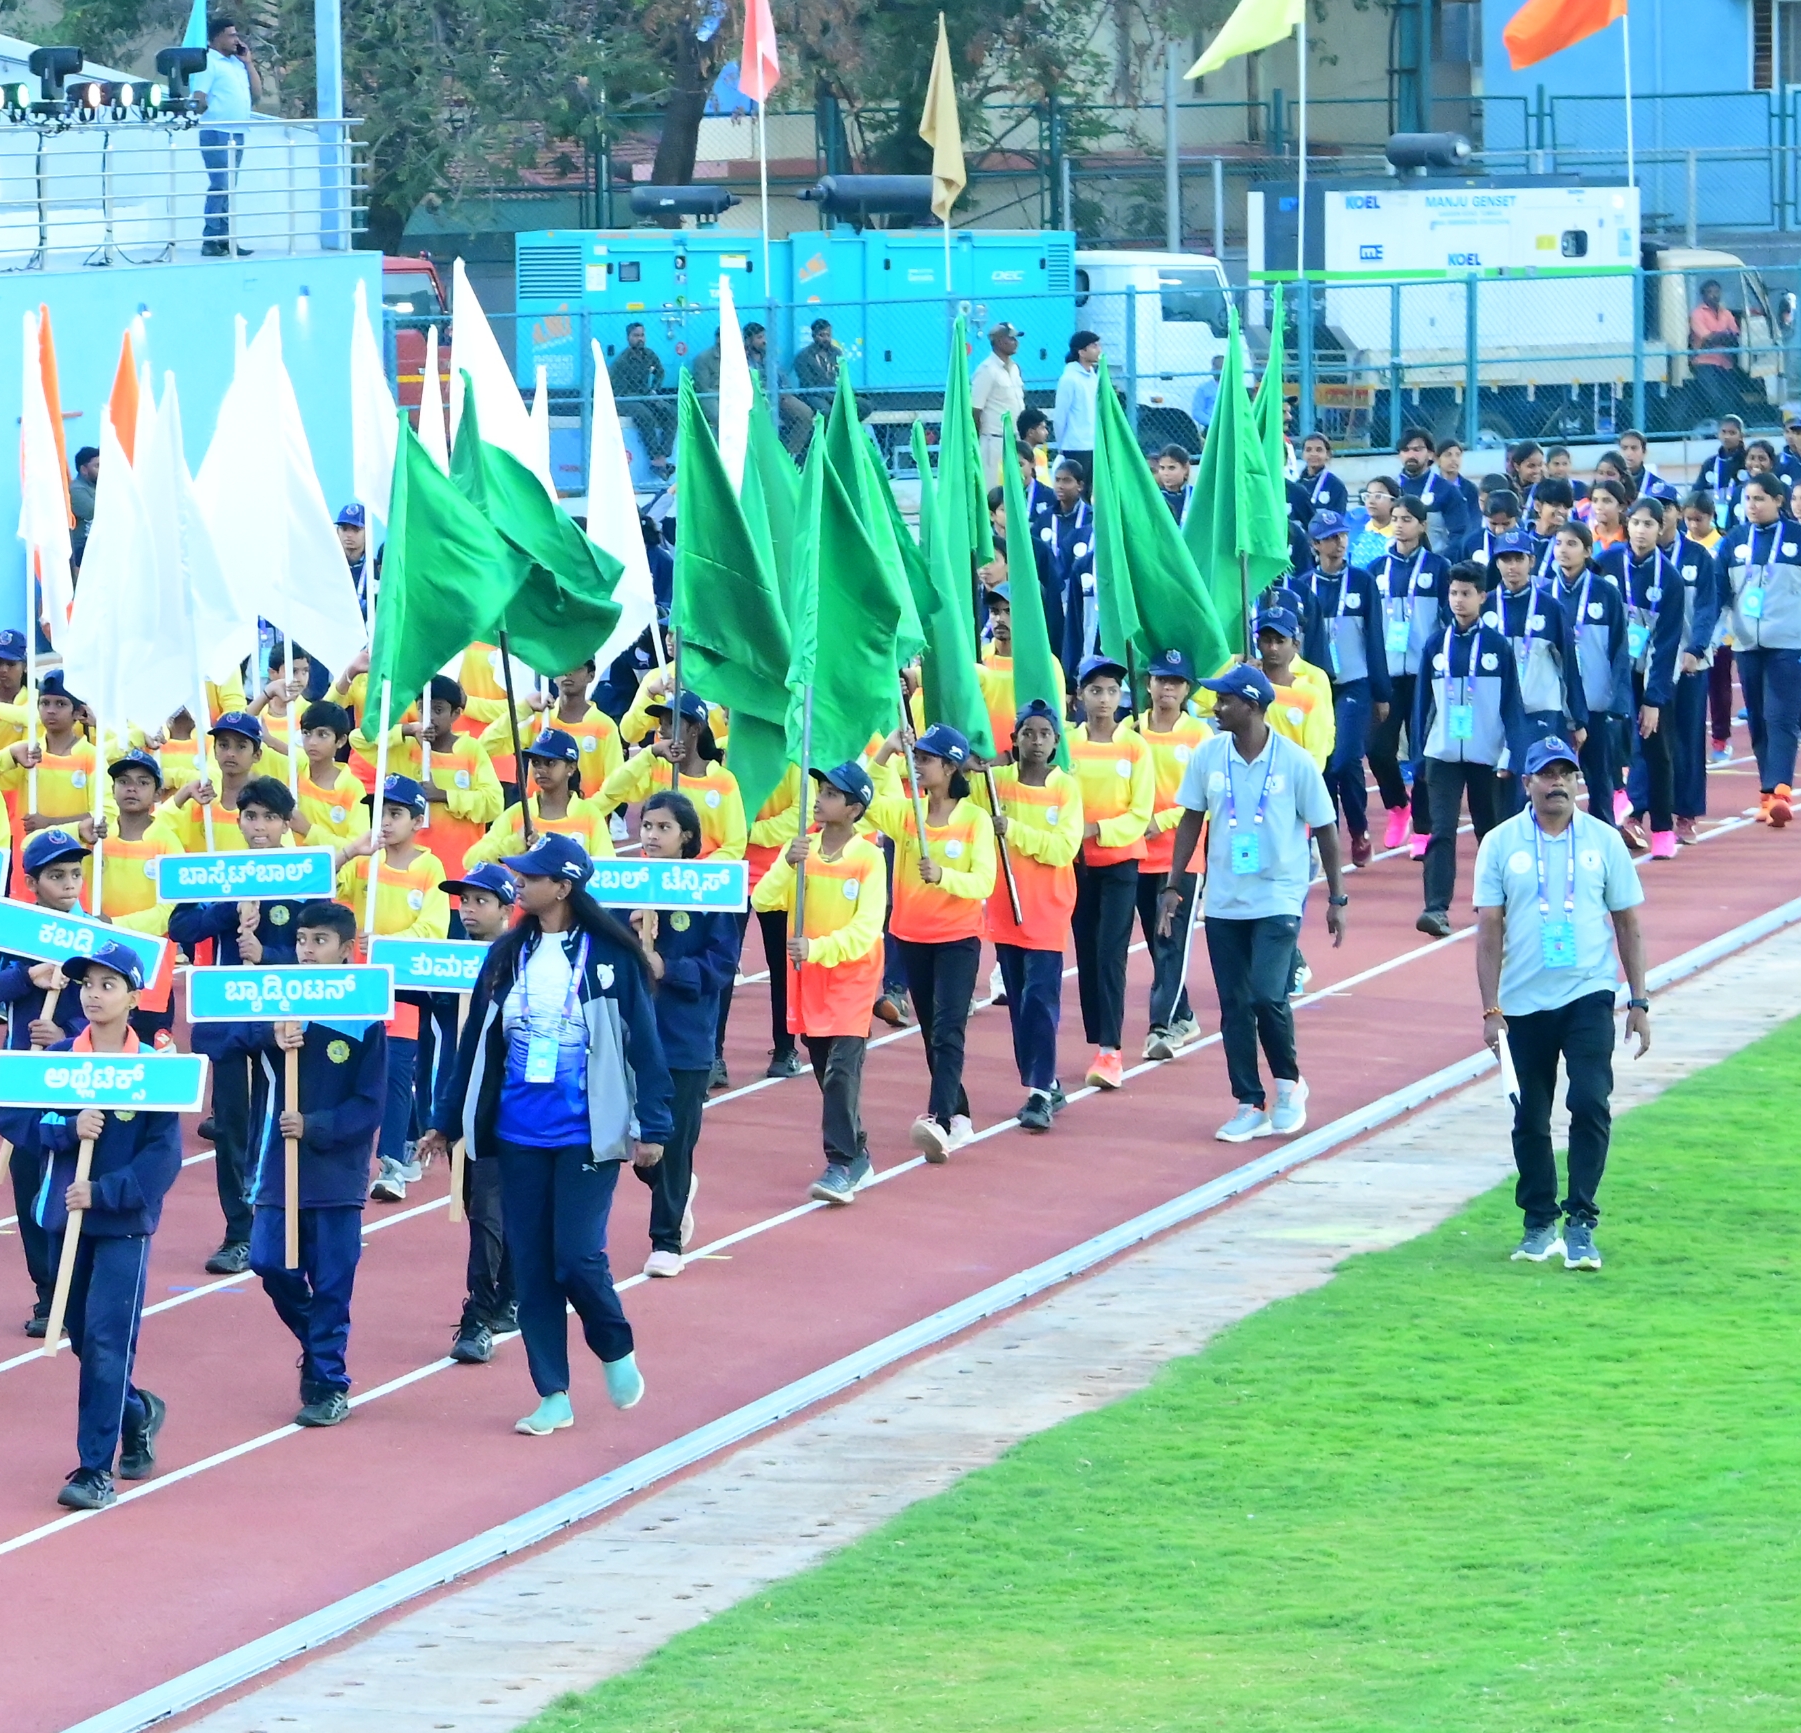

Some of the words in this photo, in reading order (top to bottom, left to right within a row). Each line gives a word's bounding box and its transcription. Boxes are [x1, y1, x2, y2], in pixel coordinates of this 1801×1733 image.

[1345, 195, 1381, 209] KOEL
[1425, 196, 1468, 208] MANJU
[1472, 195, 1517, 207] GENSET
[1448, 253, 1482, 266] KOEL
[660, 864, 731, 902] ಟೆನ್ನಿಸ್
[224, 973, 357, 1013] ಬ್ಯಾಡ್ಮಿಂಟನ್
[43, 1060, 147, 1101] ಅಥ್ಲೆಟಿಕ್ಸ್
